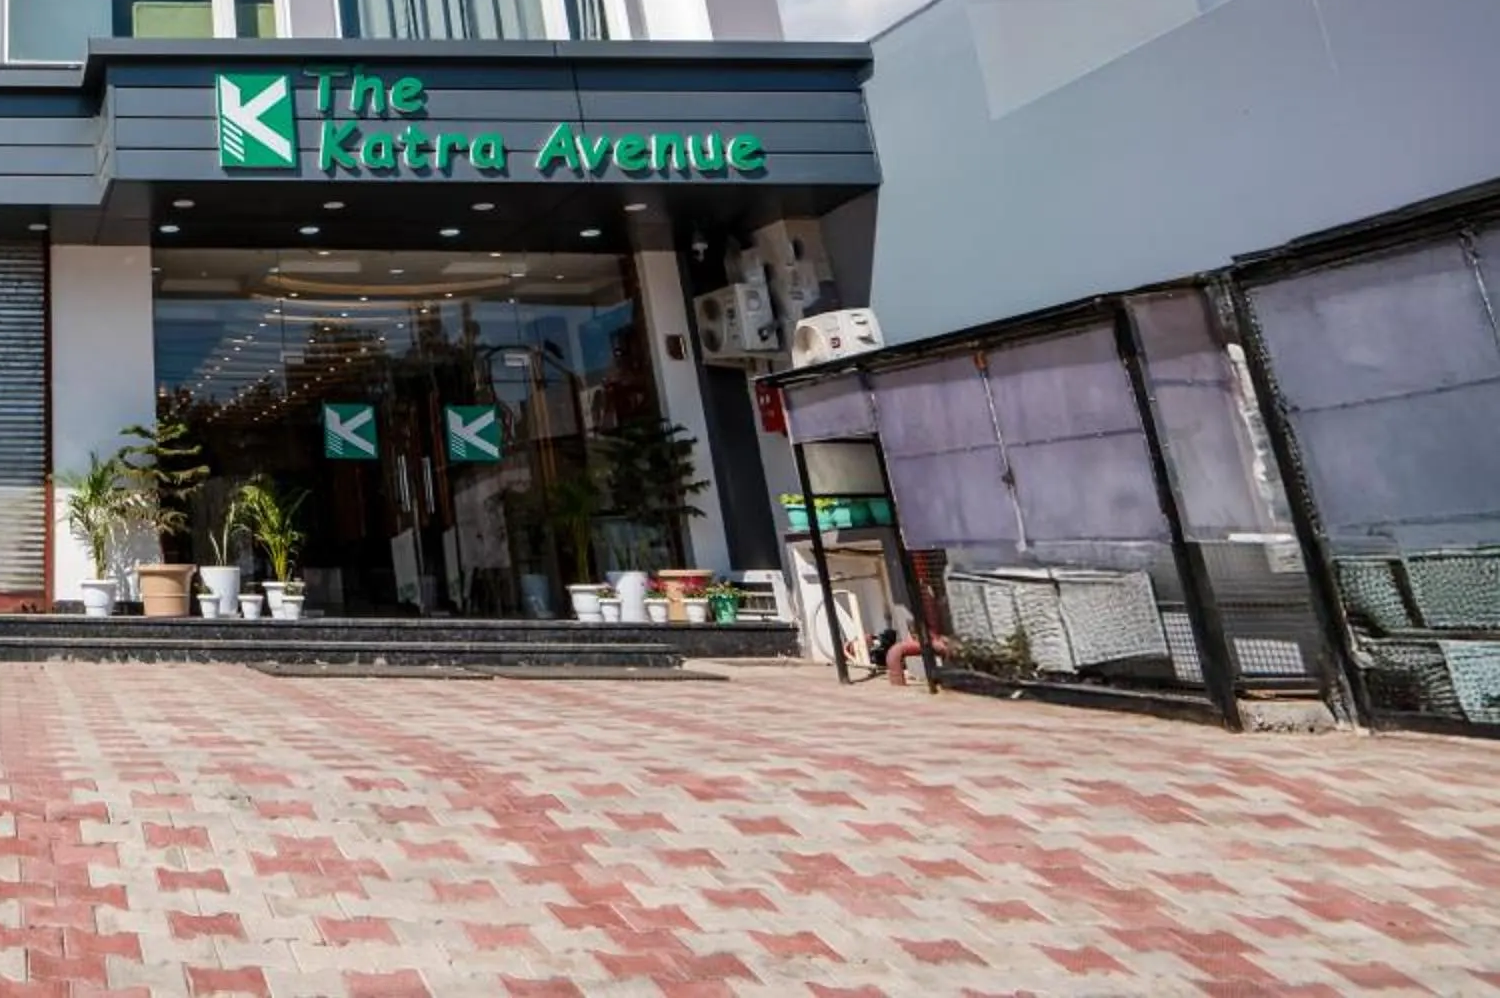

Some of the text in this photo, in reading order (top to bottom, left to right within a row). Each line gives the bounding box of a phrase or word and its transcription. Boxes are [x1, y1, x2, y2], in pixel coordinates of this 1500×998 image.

[303, 64, 424, 114] The
[319, 119, 764, 171] Katra Avenue
